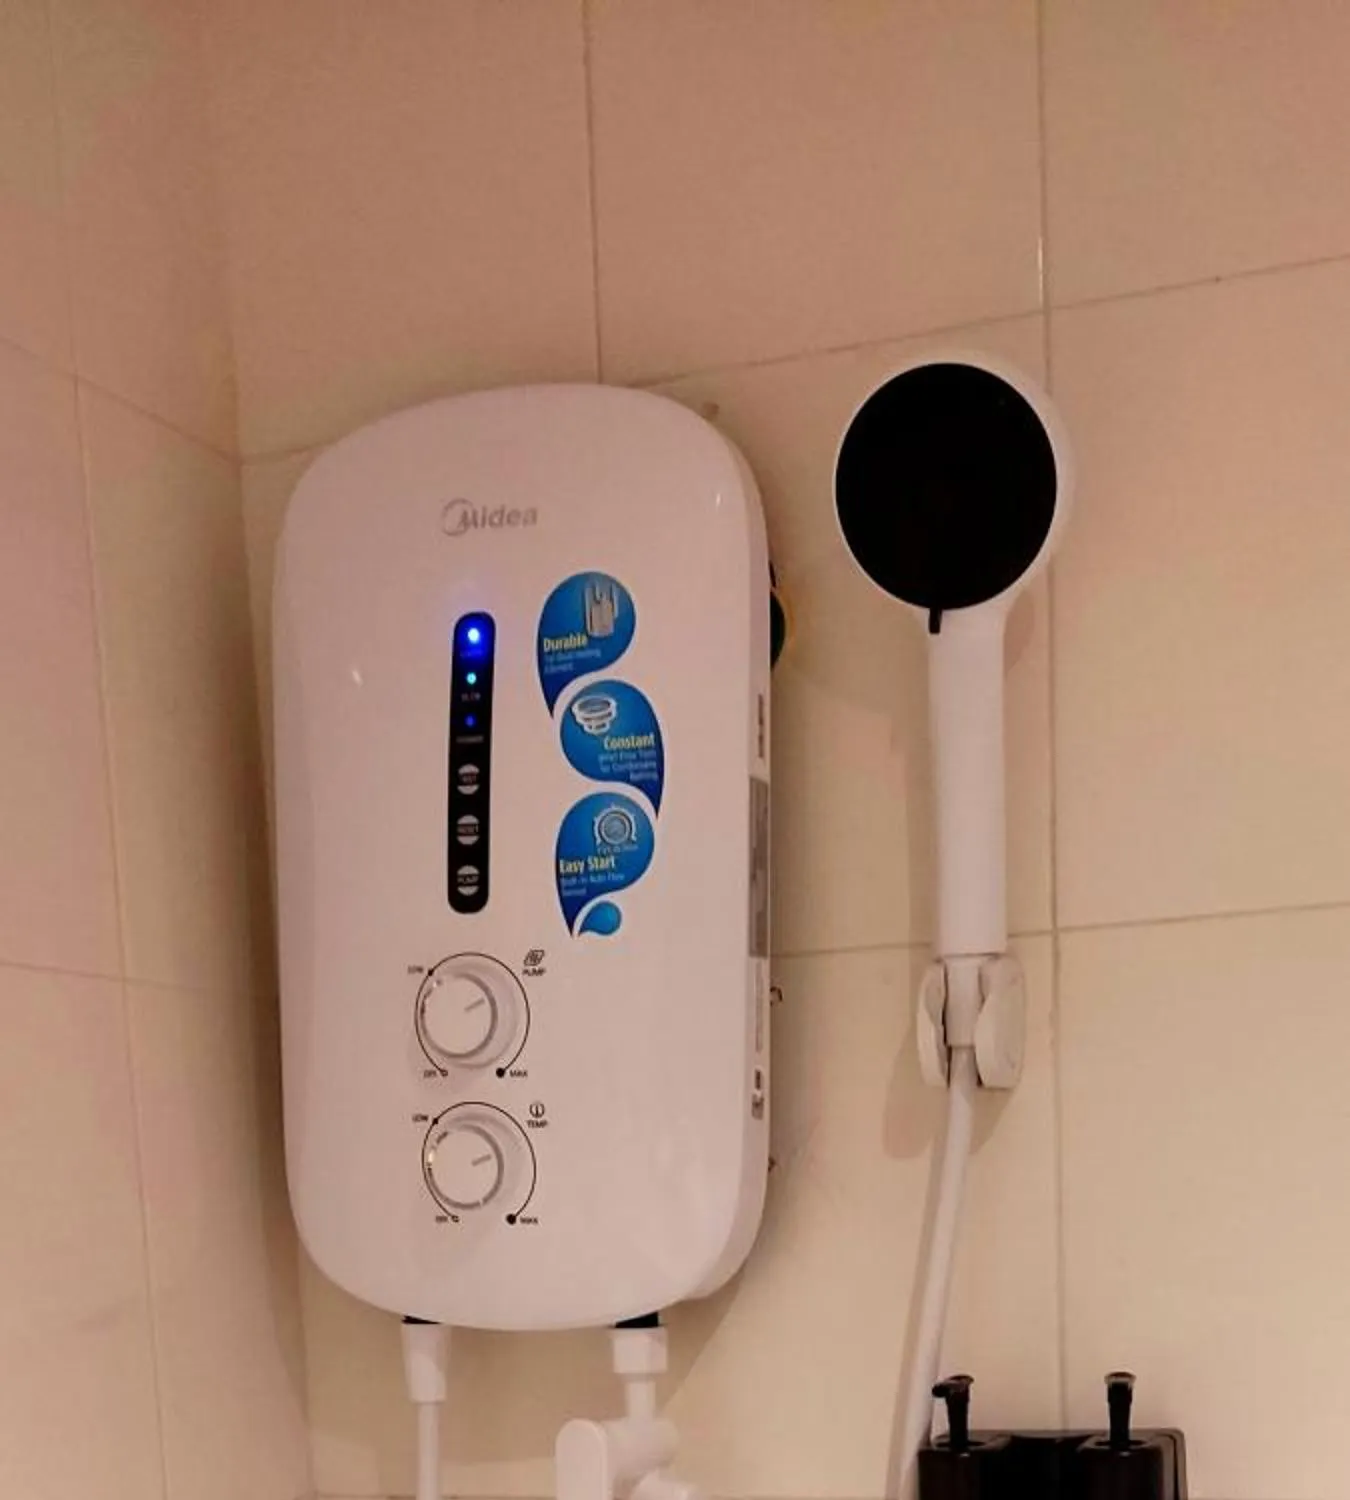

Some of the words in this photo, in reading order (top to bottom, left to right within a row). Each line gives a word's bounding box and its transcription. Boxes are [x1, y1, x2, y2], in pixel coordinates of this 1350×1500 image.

[442, 499, 538, 534] Midea
[542, 631, 588, 653] Durable
[603, 731, 656, 751] Constant
[559, 858, 586, 875] Easy
[587, 854, 616, 872] Start
[526, 1119, 548, 1129] TEMP
